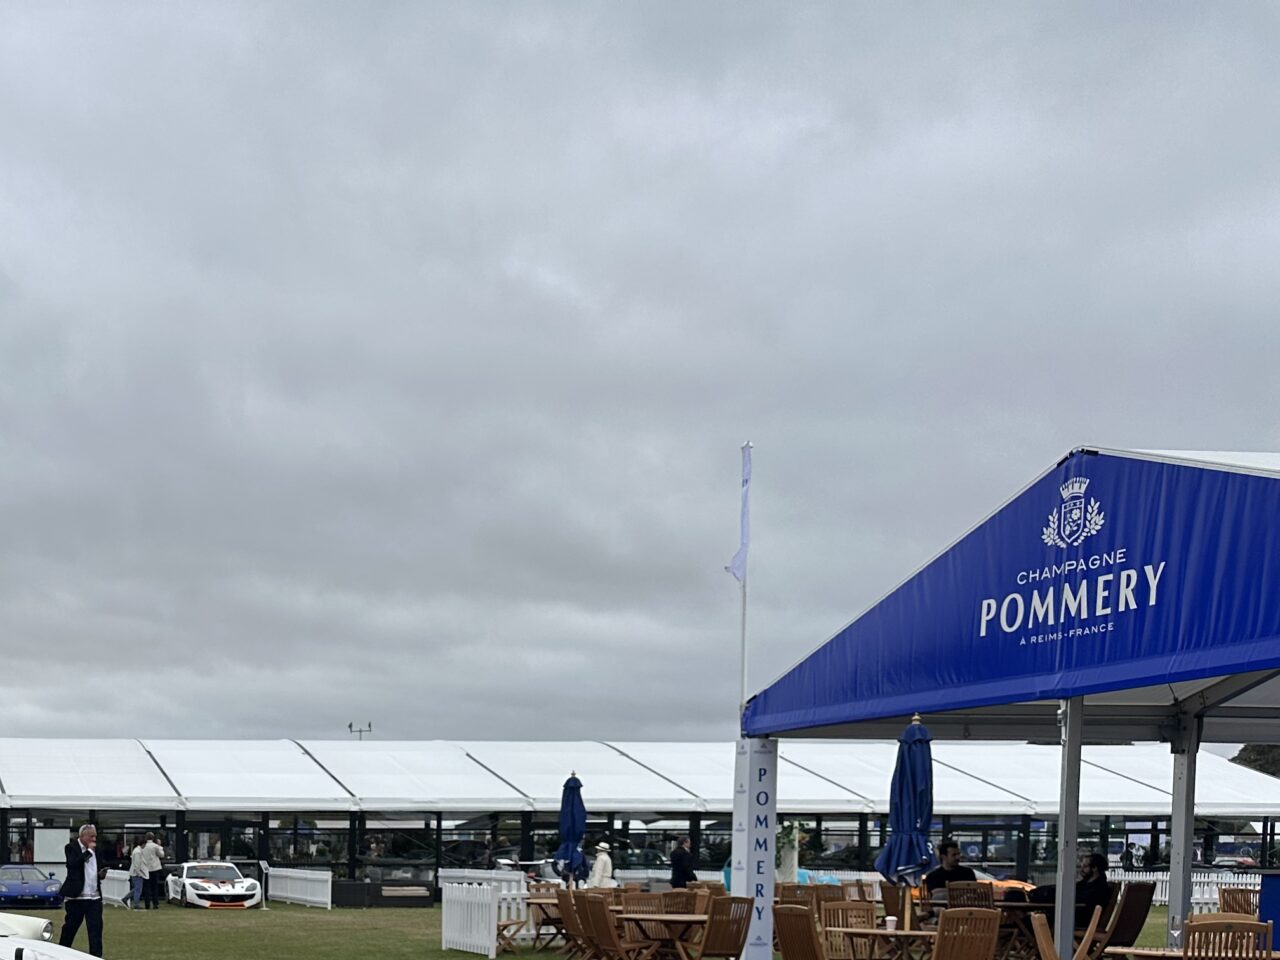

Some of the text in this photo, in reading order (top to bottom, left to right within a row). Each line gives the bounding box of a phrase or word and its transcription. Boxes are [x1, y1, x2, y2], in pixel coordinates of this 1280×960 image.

[979, 561, 1166, 637] POMMERY
[1016, 548, 1127, 585] CHAMPAGNE
[754, 767, 769, 921] POMMERY
